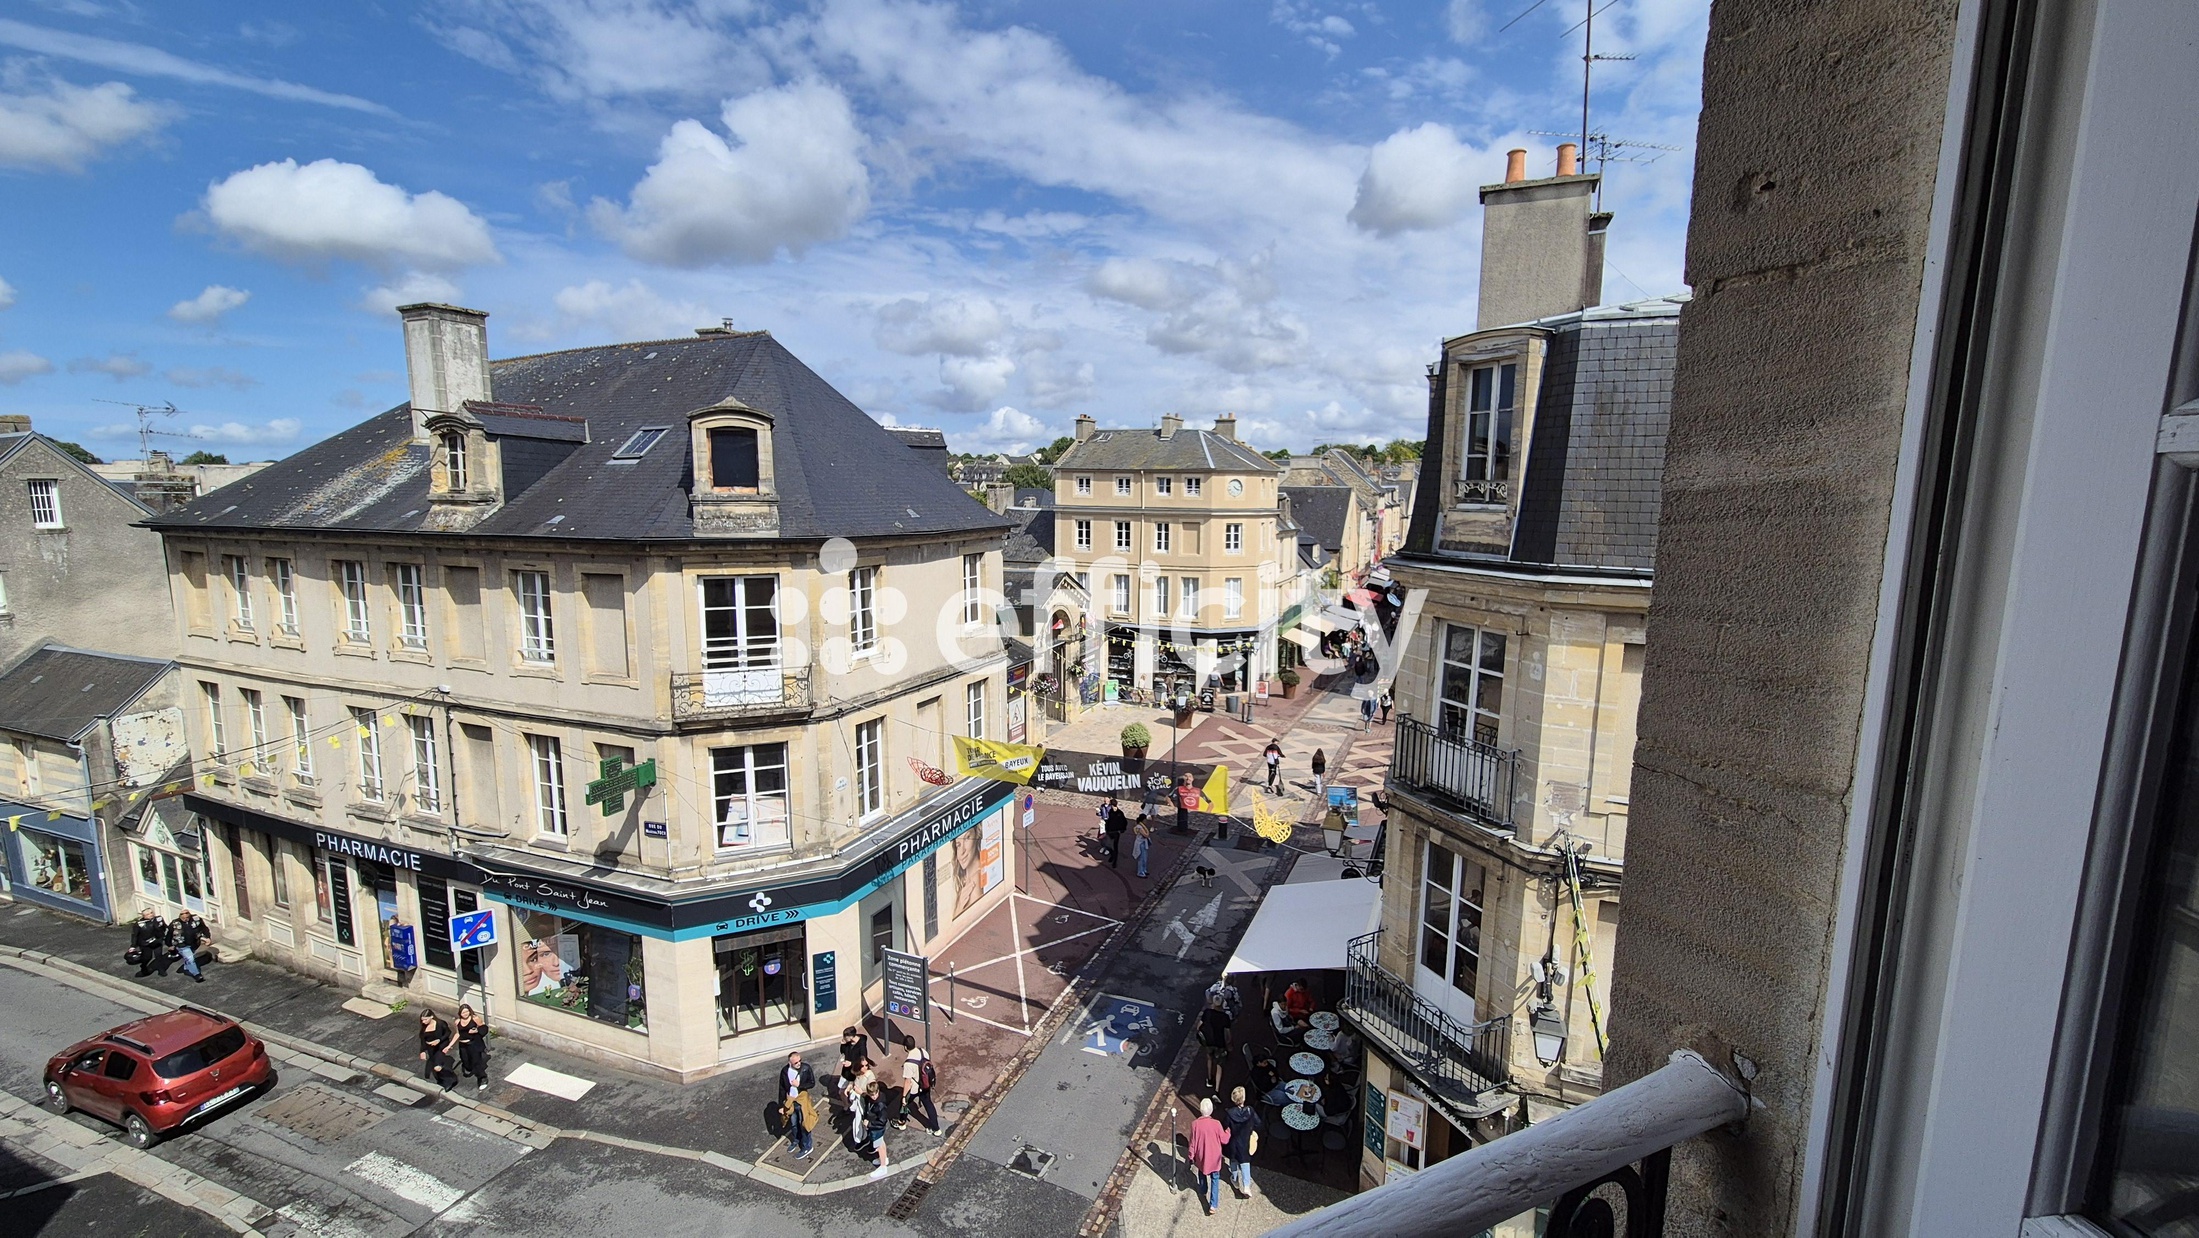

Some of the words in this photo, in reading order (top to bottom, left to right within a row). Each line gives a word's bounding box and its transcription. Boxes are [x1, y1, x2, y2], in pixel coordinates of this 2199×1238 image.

[1004, 757, 1029, 769] BAYEUX
[1041, 765, 1054, 773] TOUS
[1088, 760, 1121, 776] KÉVIN
[1037, 773, 1045, 781] LE
[1077, 773, 1142, 792] VAUQUELIN
[900, 796, 984, 861] PHARMACIE
[901, 817, 976, 870] PARAPHARMACIE
[316, 832, 422, 872] PHARMACIE
[480, 873, 500, 885] Du
[507, 877, 530, 890] Pont
[536, 883, 577, 900] Saint
[577, 891, 609, 909] Jean
[515, 894, 546, 909] DRIVE
[735, 912, 780, 928] DRIVE
